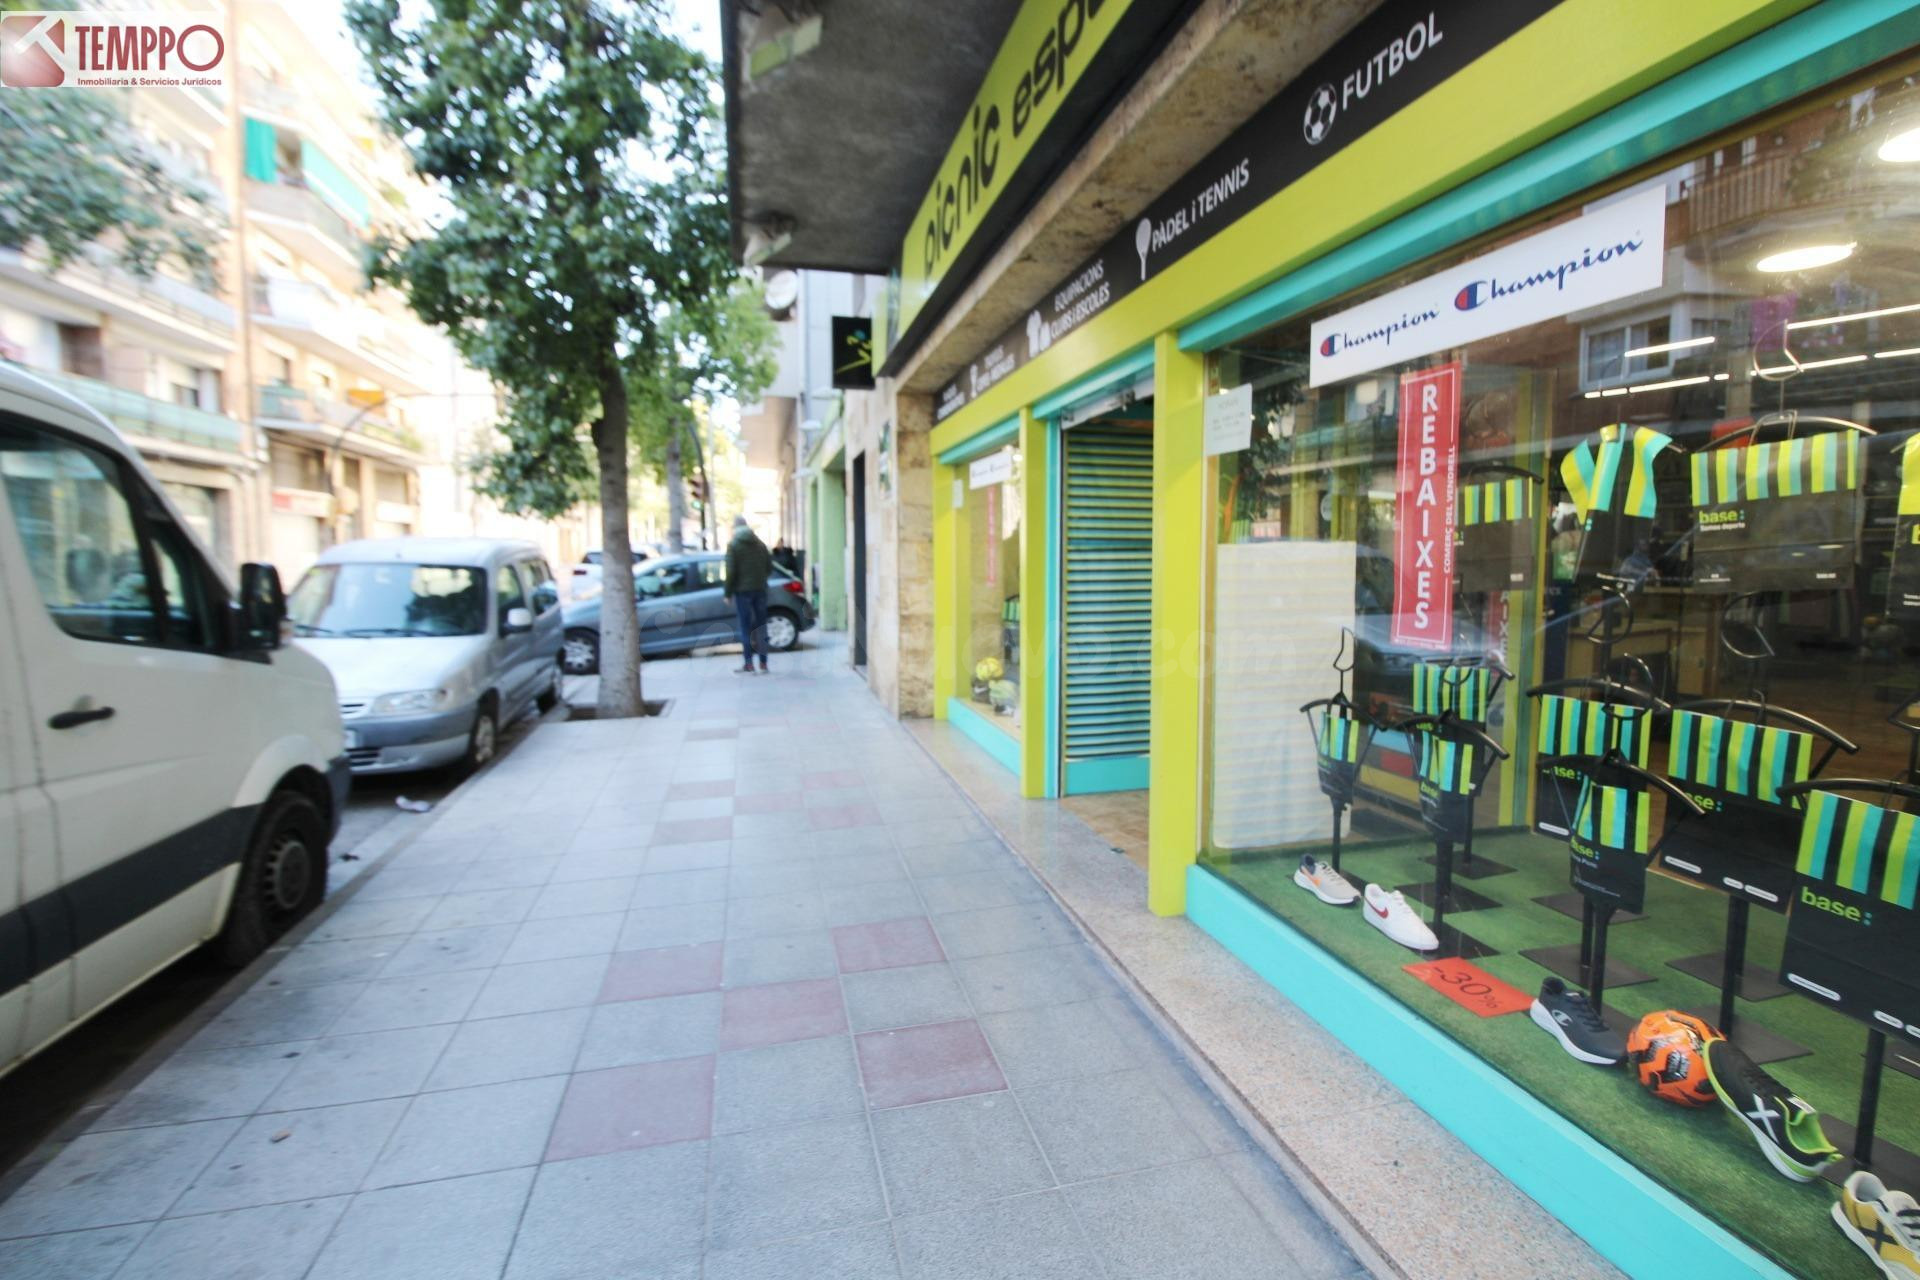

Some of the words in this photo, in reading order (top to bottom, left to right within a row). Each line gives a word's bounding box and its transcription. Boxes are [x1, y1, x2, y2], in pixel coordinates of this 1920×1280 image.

[1342, 11, 1443, 112] FUTBOL
[924, 103, 1000, 284] picnic
[1198, 157, 1249, 218] TENNIS
[1453, 240, 1644, 311] Champion
[1319, 309, 1440, 357] Champion
[1446, 445, 1456, 503] VENDRELL
[1414, 383, 1439, 630] REBAIXES
[1445, 503, 1453, 525] DEL
[1424, 966, 1498, 1009] -30%
